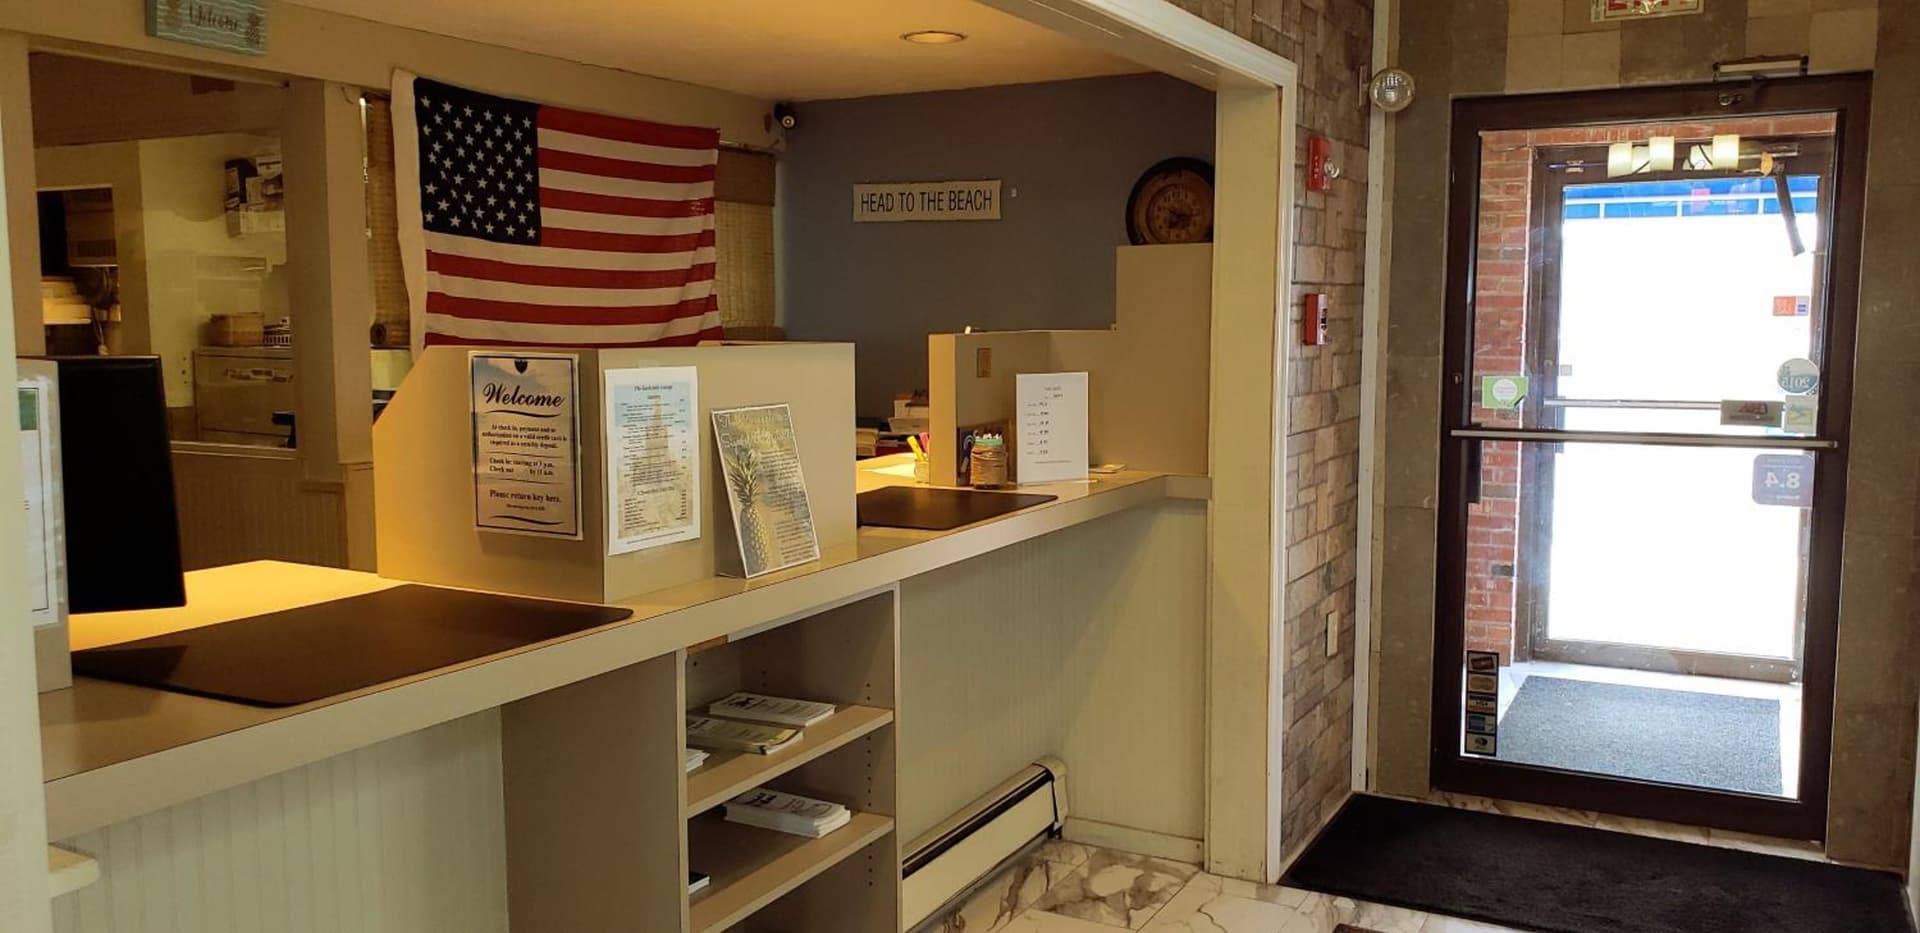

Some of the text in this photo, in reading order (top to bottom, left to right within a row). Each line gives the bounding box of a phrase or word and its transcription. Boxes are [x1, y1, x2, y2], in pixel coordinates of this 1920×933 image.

[860, 189, 993, 213] HEAD TO THE BEACH
[482, 382, 566, 407] Welcome
[489, 457, 505, 465] Check
[489, 465, 505, 473] Check
[489, 489, 509, 499] Please
[510, 491, 531, 500] return
[532, 493, 544, 503] key
